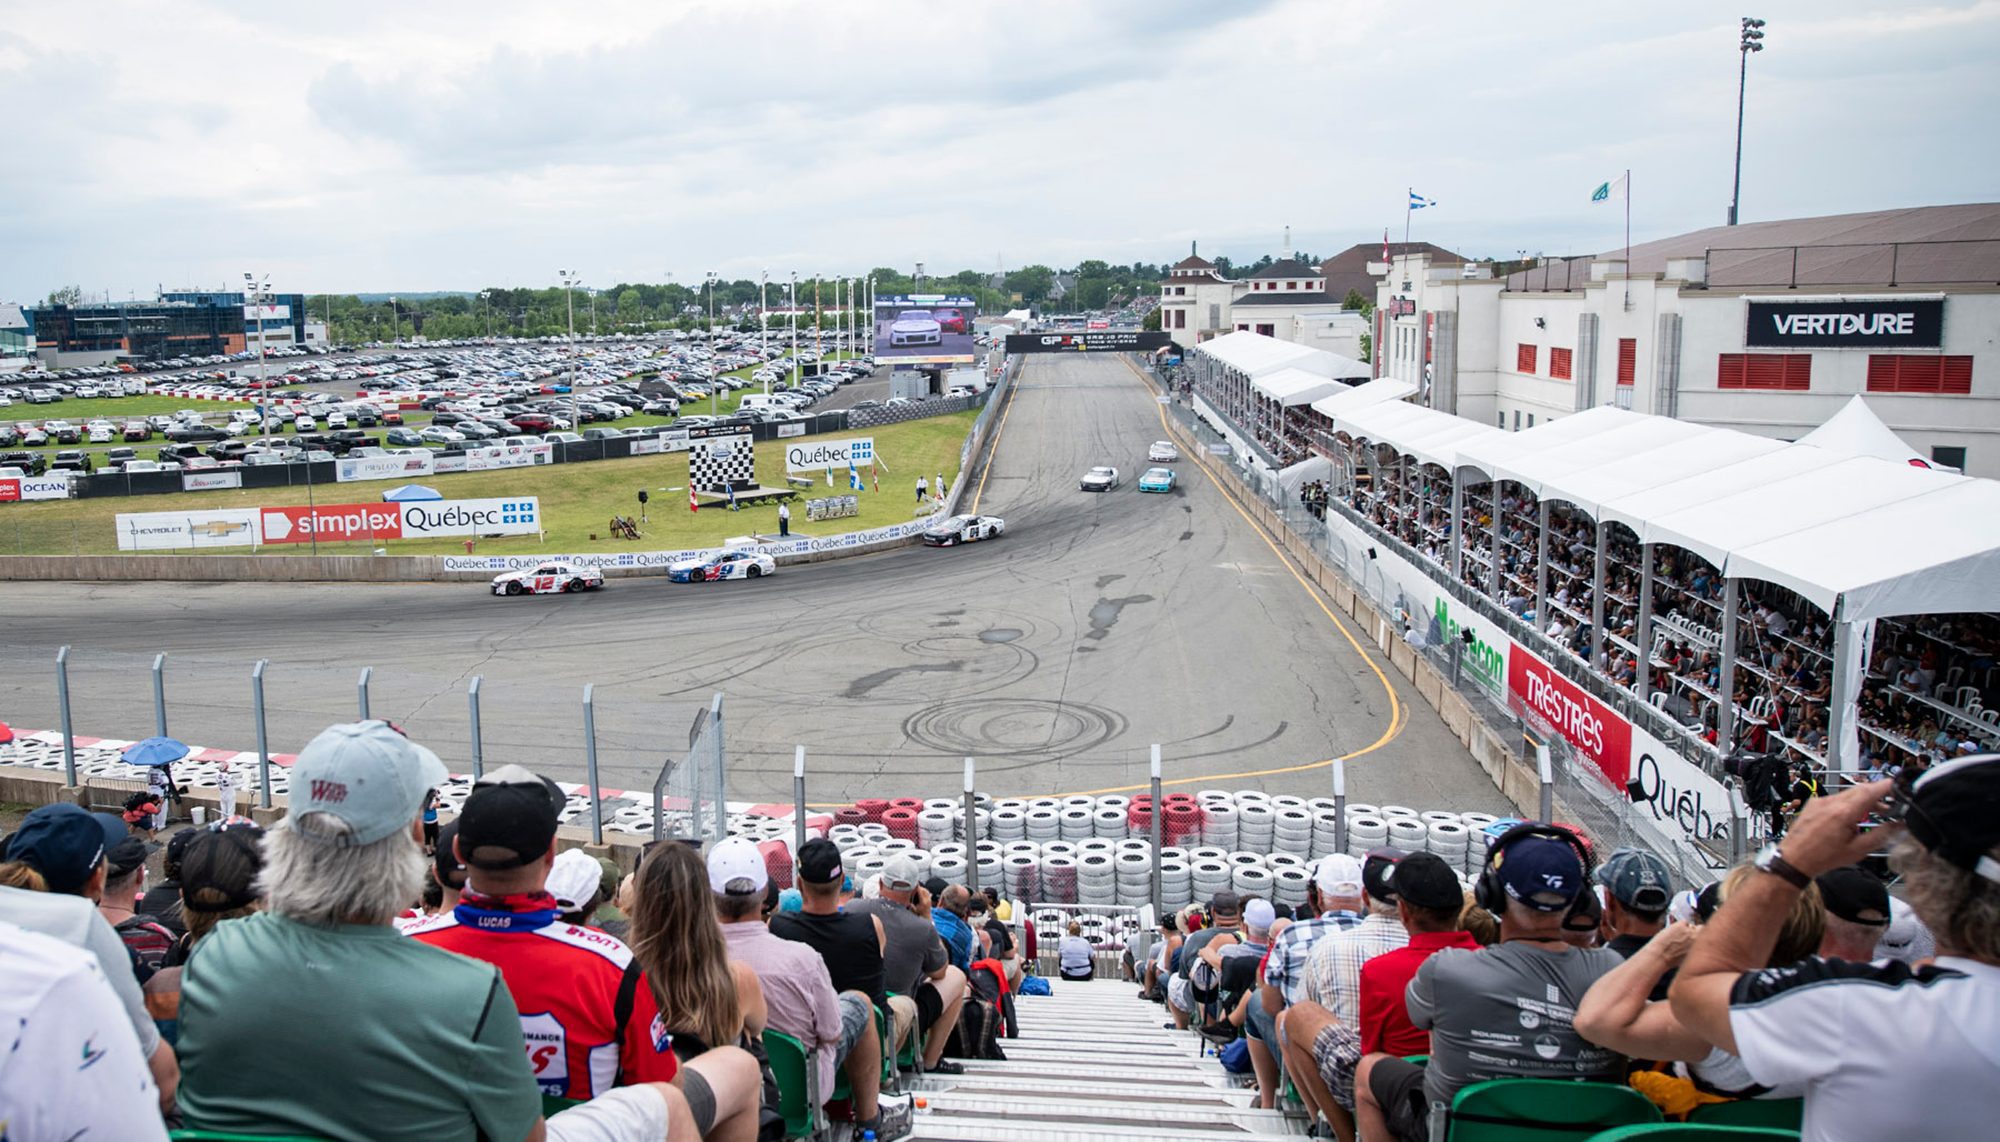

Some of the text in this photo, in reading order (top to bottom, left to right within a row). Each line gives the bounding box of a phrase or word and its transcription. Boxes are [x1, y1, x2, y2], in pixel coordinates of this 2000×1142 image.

[789, 444, 849, 467] Québec
[23, 483, 66, 493] OCEAN
[298, 509, 398, 537] simplex
[405, 506, 499, 532] Québec
[810, 535, 845, 551] Québec
[858, 530, 889, 544] Québec
[757, 542, 794, 555] Québec
[445, 557, 488, 569] Québec
[573, 554, 617, 567] Québec
[637, 551, 679, 566] Québec
[534, 576, 555, 590] 12
[1636, 753, 1730, 839] Québe
[478, 916, 511, 928] LUCAS
